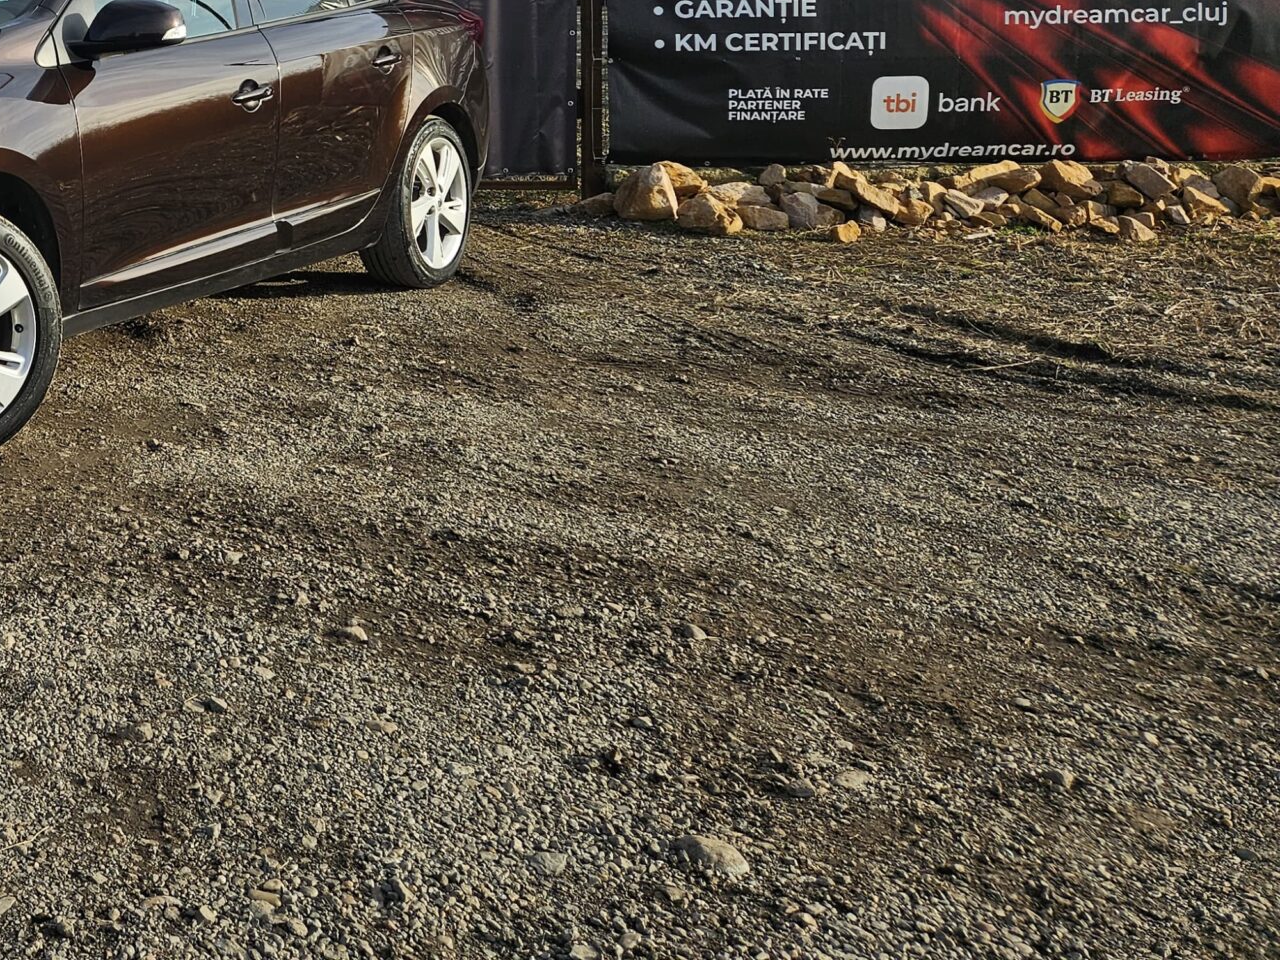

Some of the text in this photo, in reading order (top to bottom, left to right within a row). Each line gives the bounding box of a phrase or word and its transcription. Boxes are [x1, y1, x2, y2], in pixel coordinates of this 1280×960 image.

[1004, 1, 1229, 30] mydreamcar_cluj
[675, 31, 887, 56] KM CERTIFICAȚI
[728, 86, 829, 100] PLATĂ ÎN RATE
[1048, 89, 1073, 104] BT
[1089, 88, 1114, 103] BT
[728, 100, 801, 110] PARTENER
[883, 92, 1001, 113] tbi bank
[728, 110, 805, 123] FINANȚARE
[830, 142, 1075, 160] www.mydreamcar.ro
